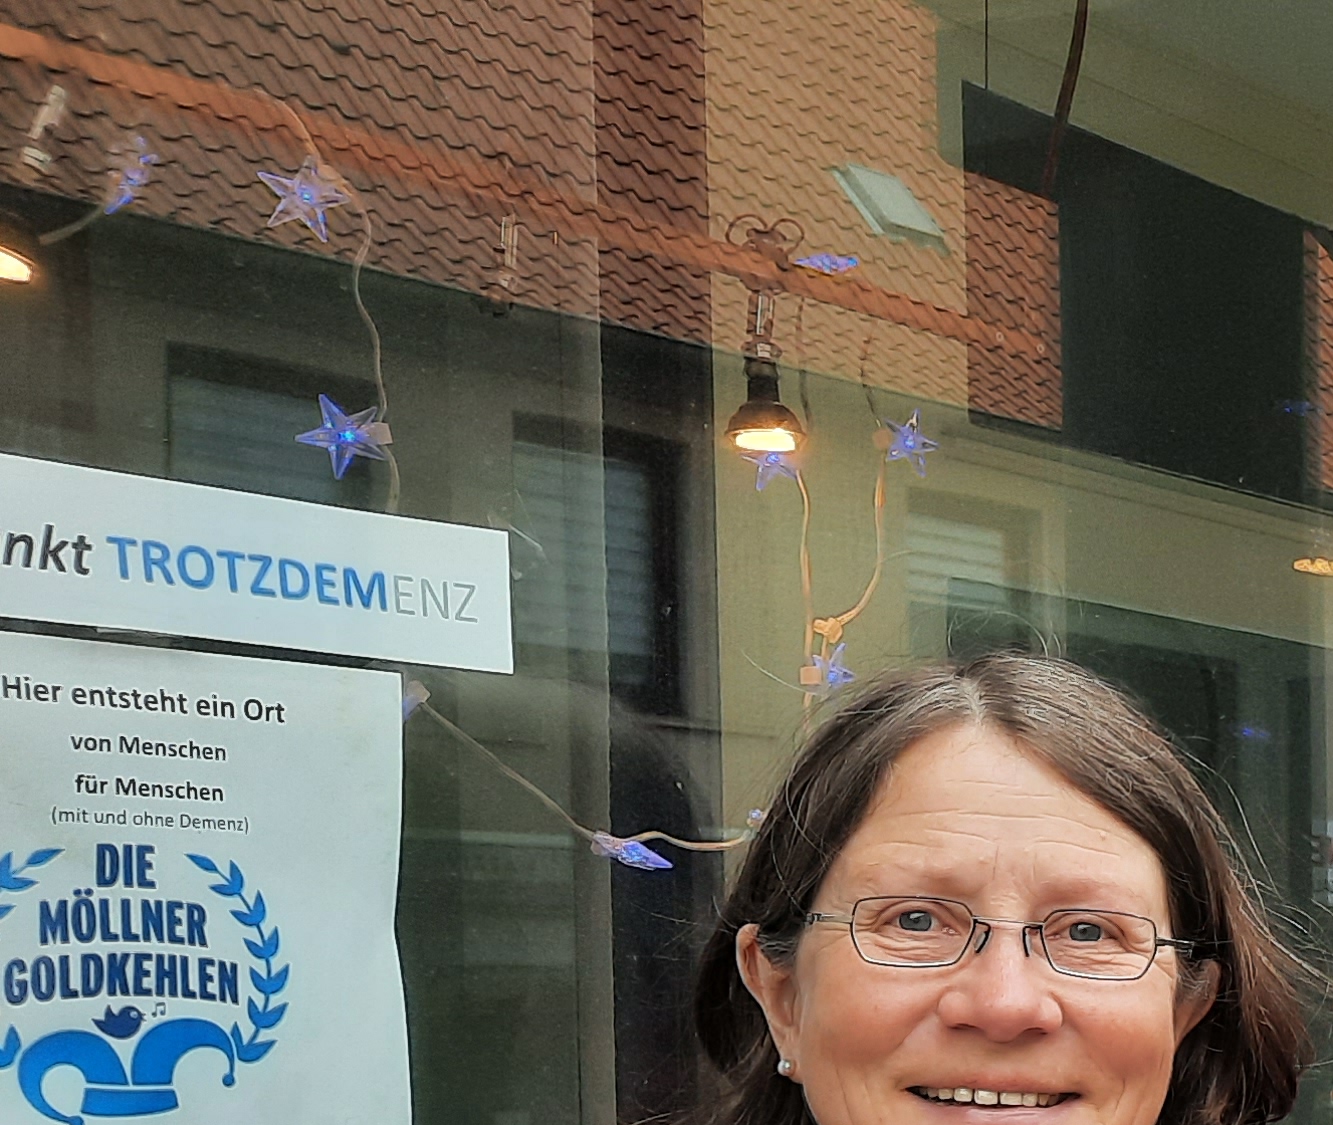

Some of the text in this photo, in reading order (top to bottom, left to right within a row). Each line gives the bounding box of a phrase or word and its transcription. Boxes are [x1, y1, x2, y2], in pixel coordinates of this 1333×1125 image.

[107, 536, 479, 623] TROTZDEMENZ
[2, 674, 285, 723] Hier entsteht ein Ort
[71, 734, 227, 761] von Menschen
[75, 775, 224, 802] für Menschen
[52, 806, 249, 834] (mit und ohne Demenz)
[96, 843, 156, 889] DIE
[39, 888, 208, 947] MÖLLNER
[4, 952, 239, 1006] GOLDKEHLEN
